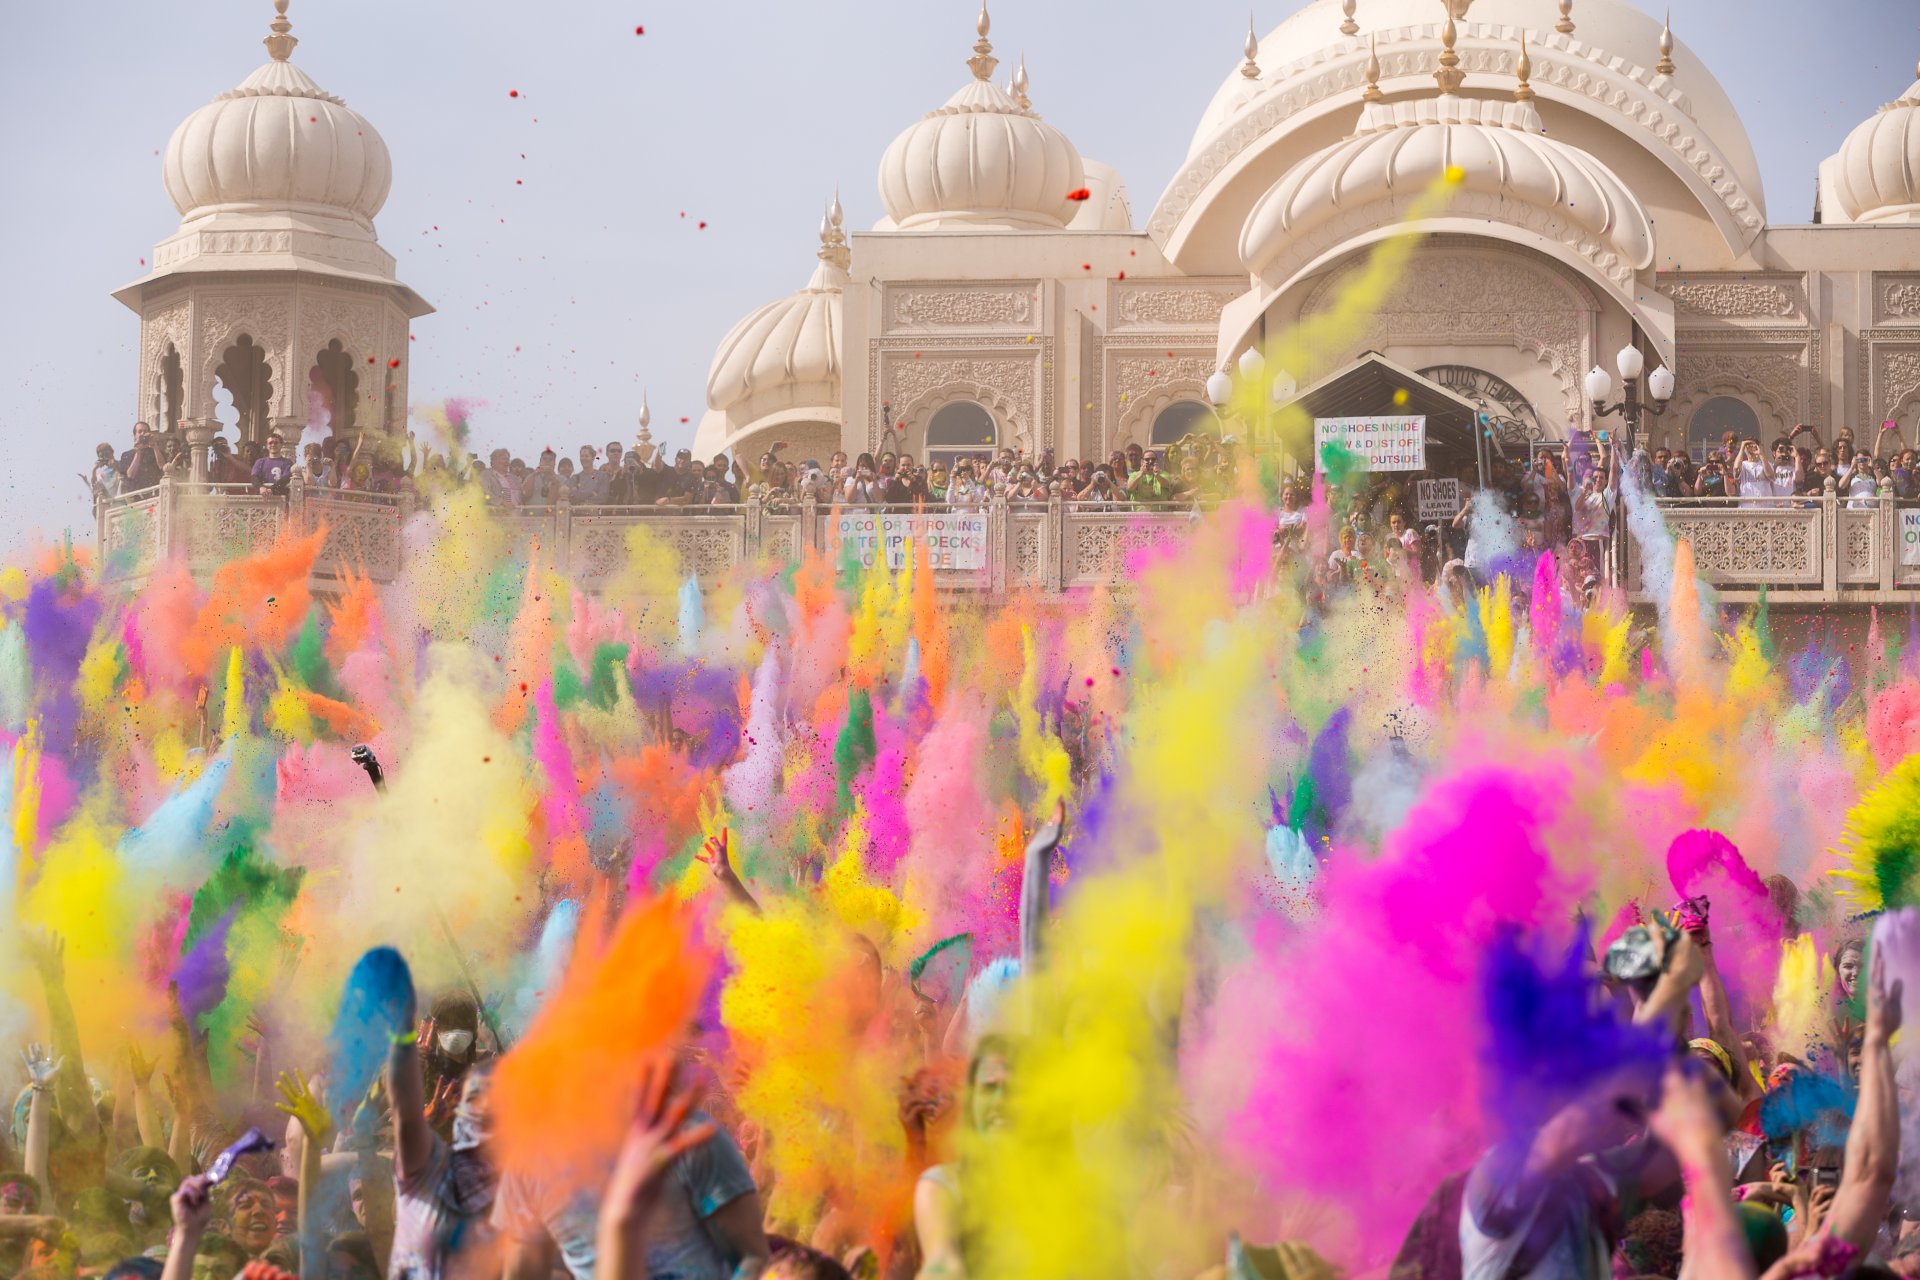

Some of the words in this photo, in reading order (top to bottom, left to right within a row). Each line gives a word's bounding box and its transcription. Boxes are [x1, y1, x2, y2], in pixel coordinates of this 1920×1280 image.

[1438, 369, 1477, 387] LOTUS
[1484, 378, 1527, 418] TEMPLE
[1322, 424, 1338, 433] NO
[1341, 424, 1378, 432] SHOES
[1382, 422, 1418, 432] INSIDE
[1356, 440, 1362, 448] &
[1366, 440, 1395, 448] DUST
[1399, 438, 1420, 447] OFF
[1371, 455, 1418, 464] OUTSIDE
[1420, 482, 1430, 500] NO
[1432, 481, 1456, 500] SHOES
[855, 520, 902, 531] COOR
[858, 536, 921, 548] TEPE
[928, 536, 980, 548] DECKS
[1905, 530, 1920, 543] O
[894, 552, 952, 566] INDE
